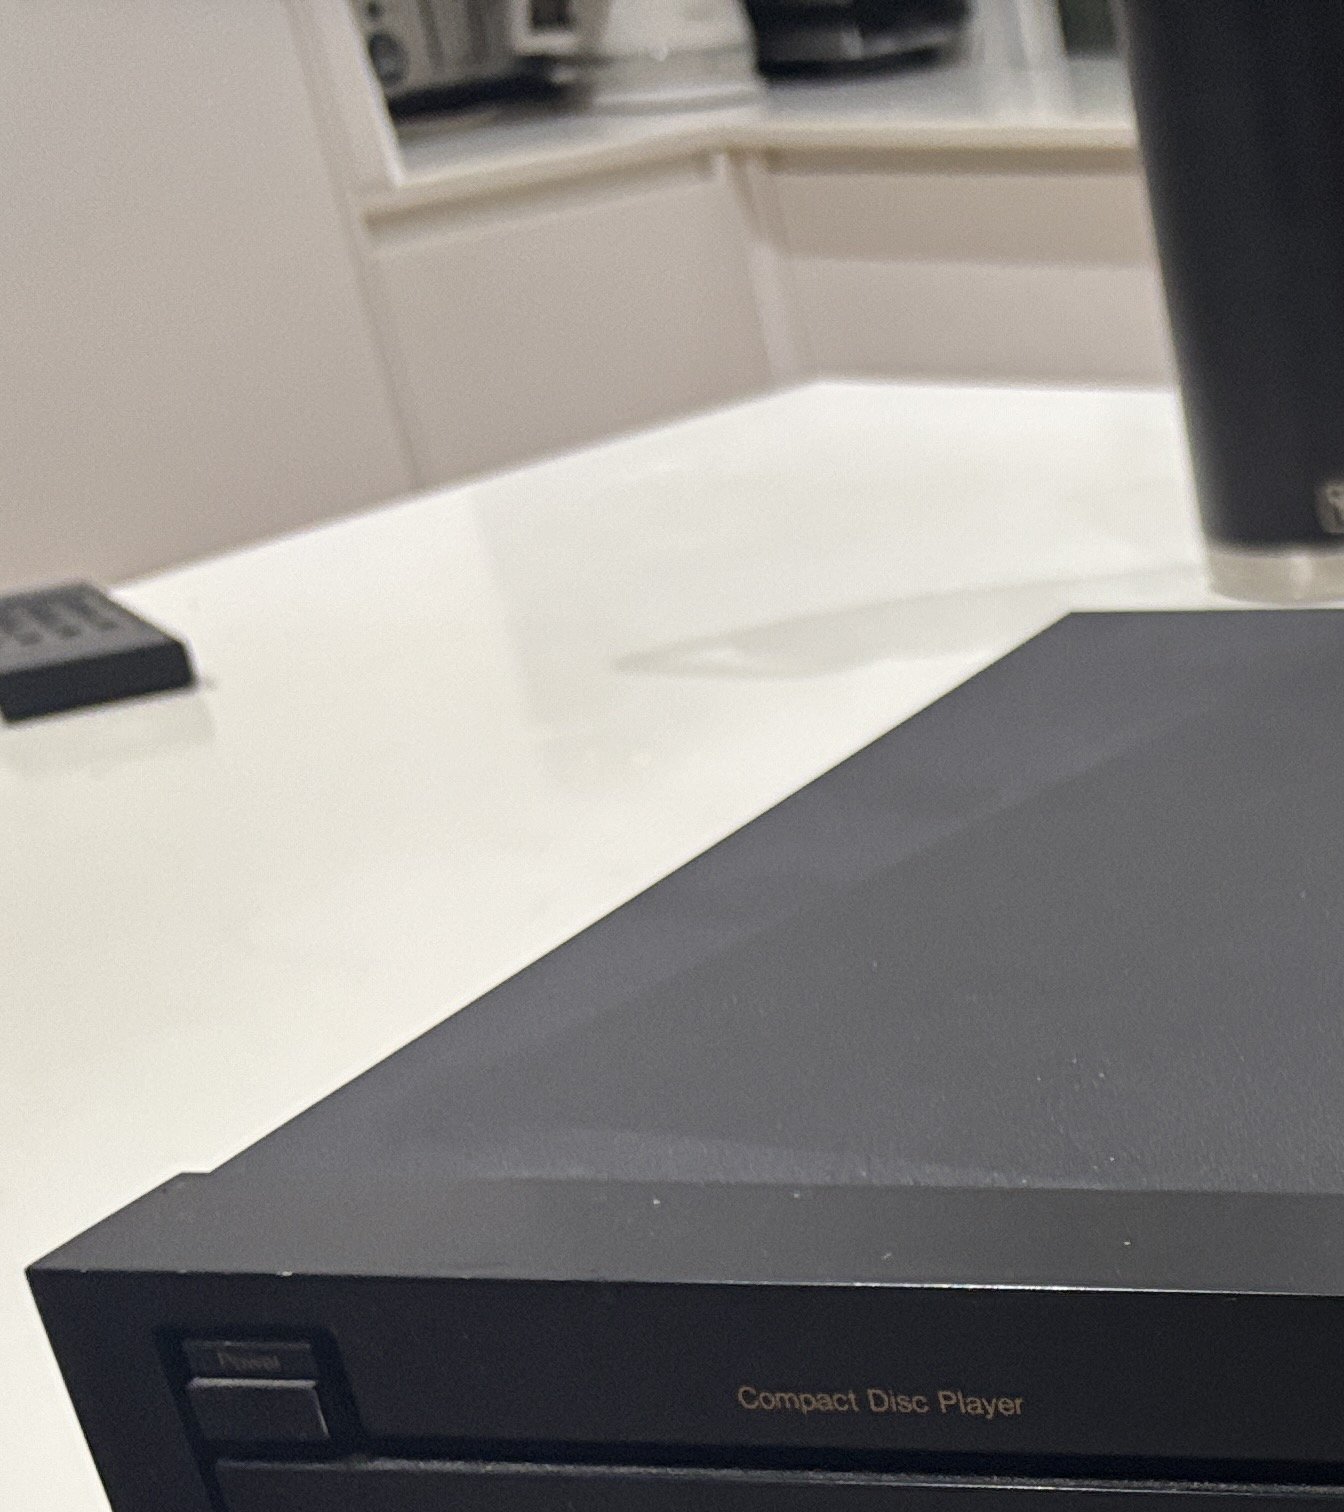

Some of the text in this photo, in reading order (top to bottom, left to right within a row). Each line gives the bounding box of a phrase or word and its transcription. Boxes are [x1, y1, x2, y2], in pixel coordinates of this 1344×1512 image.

[737, 1386, 1024, 1419] Compact Disc Player
